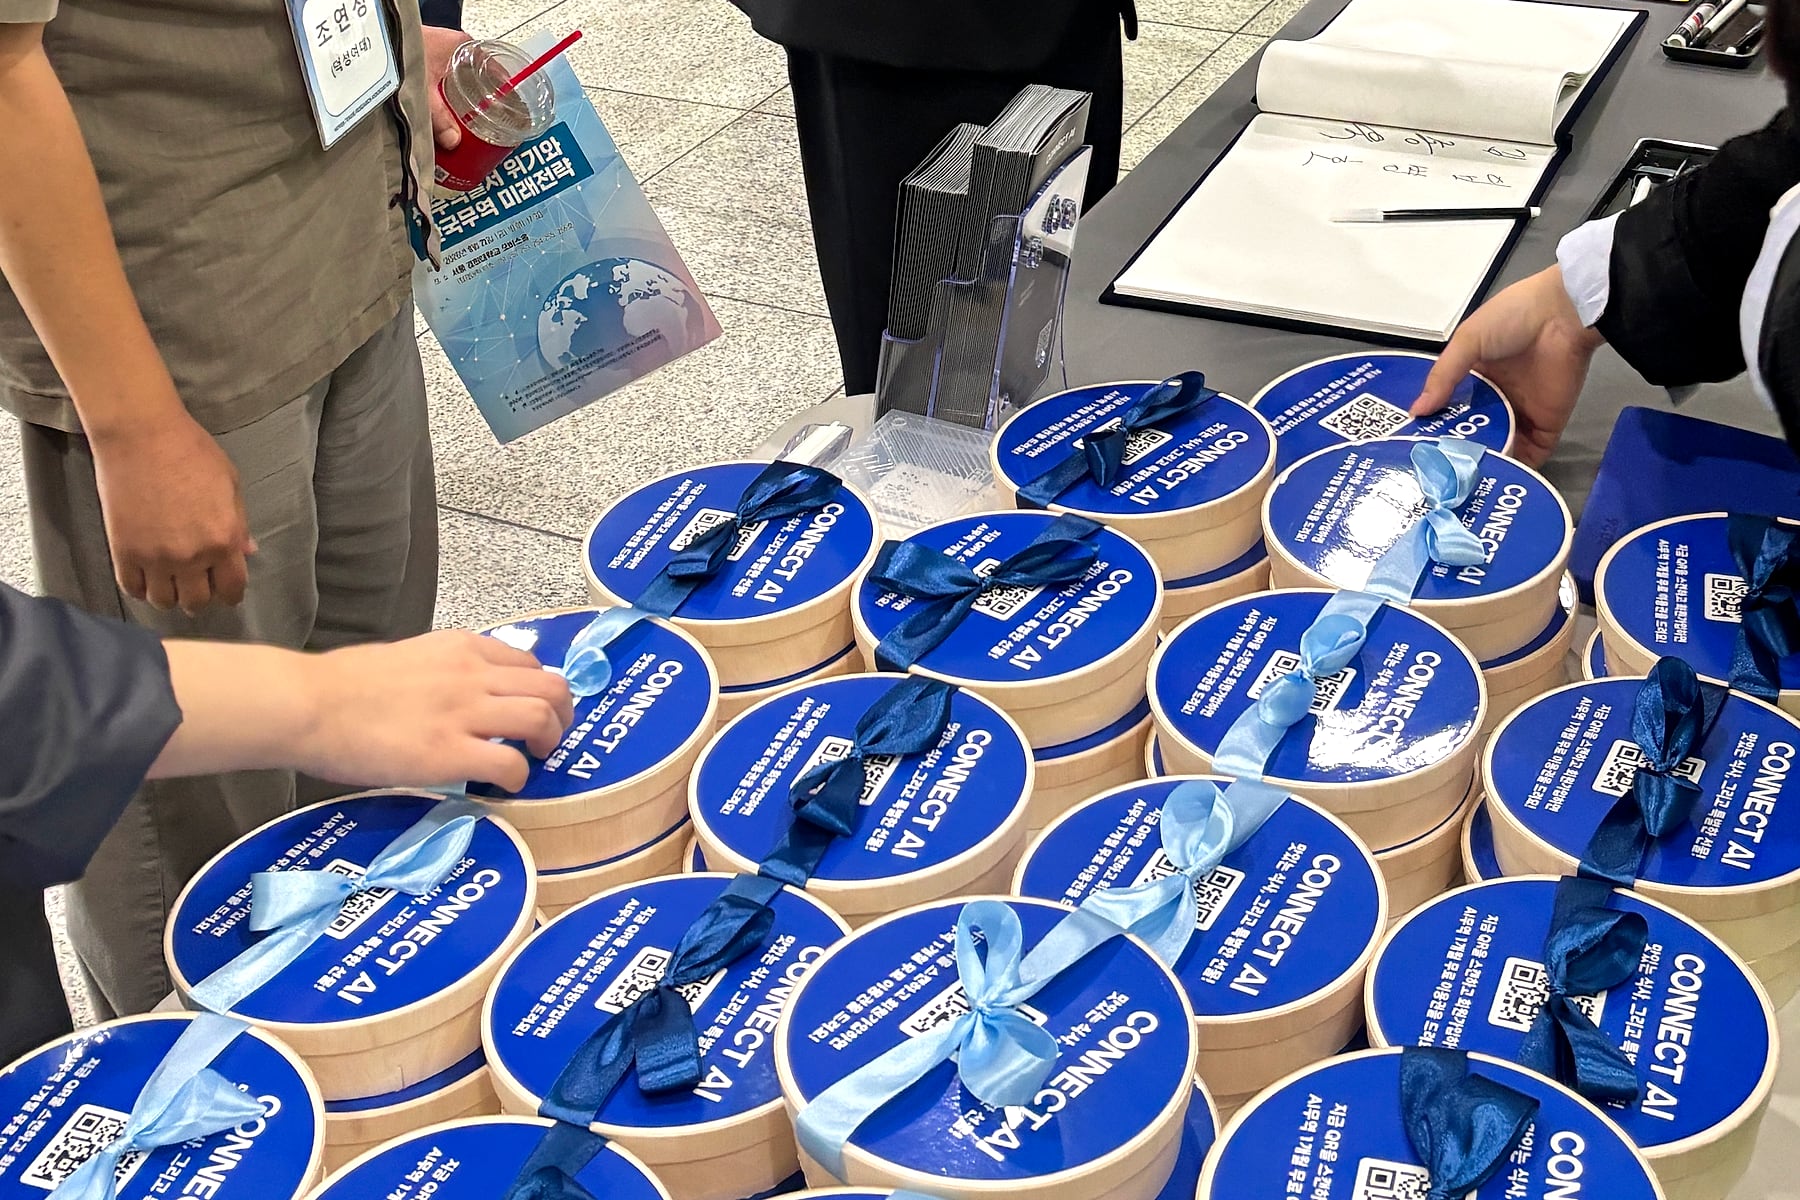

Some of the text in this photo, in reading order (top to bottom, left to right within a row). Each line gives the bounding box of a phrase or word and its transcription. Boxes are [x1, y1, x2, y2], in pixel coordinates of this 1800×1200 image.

[435, 196, 499, 243] 국무역
[497, 157, 575, 210] 미래전략
[503, 136, 563, 179] 위기와
[1130, 432, 1248, 505] CONNECT AI
[754, 503, 844, 602] CONNECT AI
[1457, 558, 1485, 585] AI
[1009, 570, 1132, 670] CONNECT AI
[1373, 643, 1409, 686] 맛있는 식사,
[568, 661, 683, 779] CONNECT AI
[891, 730, 992, 858] CONNECT AI
[1692, 732, 1758, 859] 맛있는 식사, 그리고 특별한 선물!
[1721, 742, 1795, 869] CONNECT AI
[337, 869, 501, 1004] CONNECT AI
[1201, 843, 1307, 984] 맛있는 식사, 그리고 특별한 선물!
[1230, 854, 1340, 996] CONNECT AI
[693, 946, 826, 1102] CONNECT AI
[714, 935, 795, 1025] 맛있는 식사, 그리고
[1053, 991, 1129, 1046] 맛있는 식사,
[1625, 1003, 1647, 1039] 그리고
[1632, 977, 1654, 1000] 식사,
[1641, 954, 1705, 1120] CONNECT AI
[973, 1011, 1158, 1162] CONNECT AI
[1319, 1103, 1347, 1162] 지금 QR을
[150, 1153, 190, 1193] 그리고
[177, 1095, 281, 1200] CONNE
[405, 1147, 442, 1182] AI무역
[432, 1159, 459, 1181] 지금
[1287, 1094, 1322, 1193] AI무역 1개월 무료
[1505, 1168, 1529, 1199] 식사,
